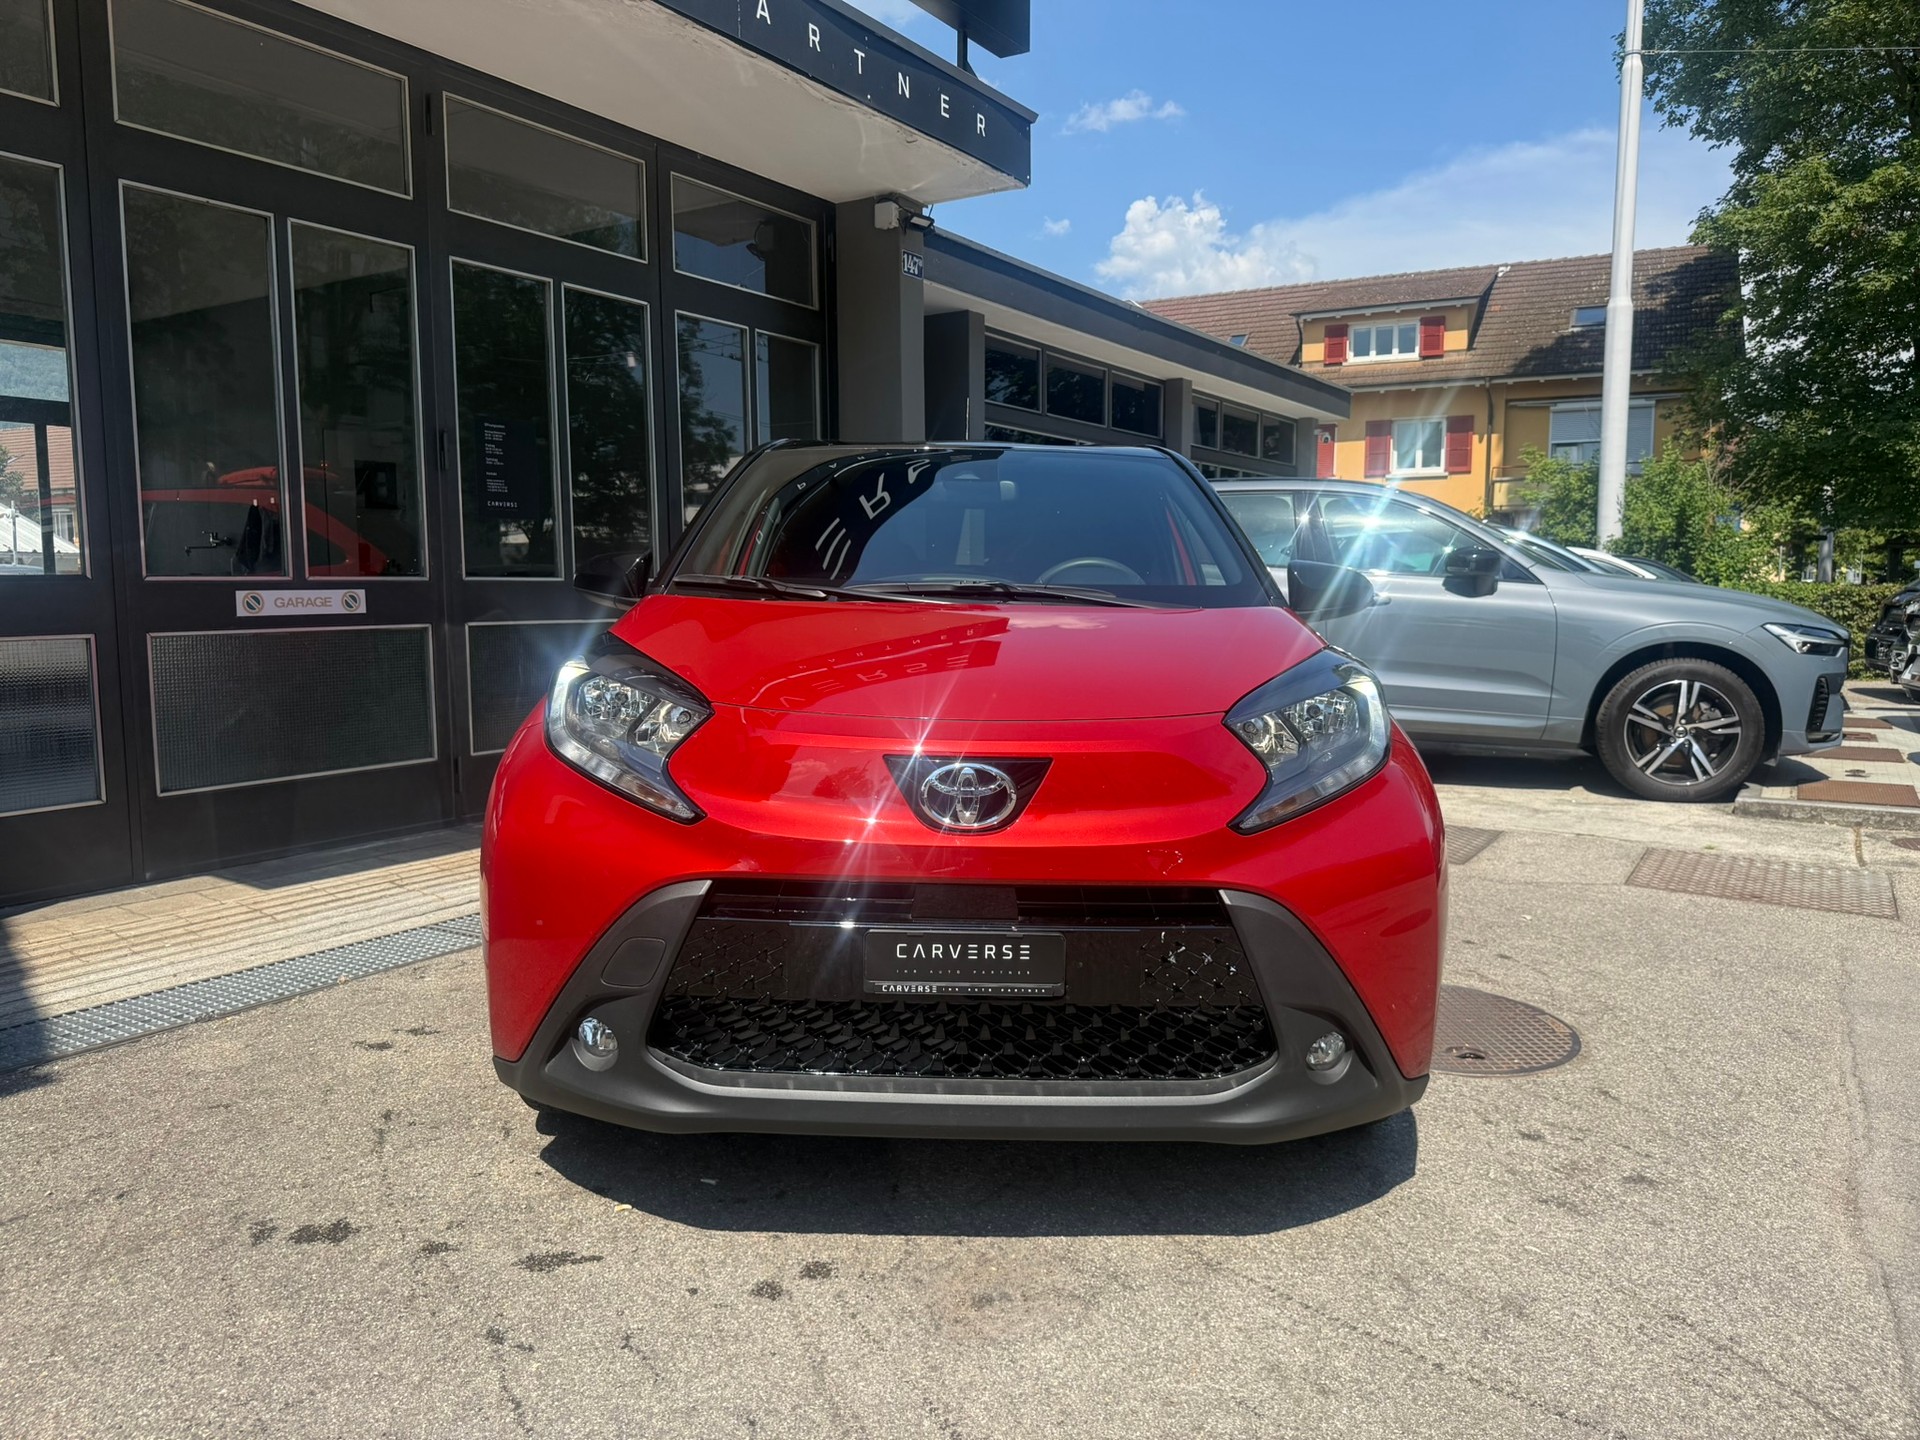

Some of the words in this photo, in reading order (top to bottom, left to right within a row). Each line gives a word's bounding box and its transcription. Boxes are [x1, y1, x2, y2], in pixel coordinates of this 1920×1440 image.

[274, 597, 333, 608] GARAGE
[896, 943, 1031, 959] CARVERSE
[882, 985, 937, 993] CARVERSE
